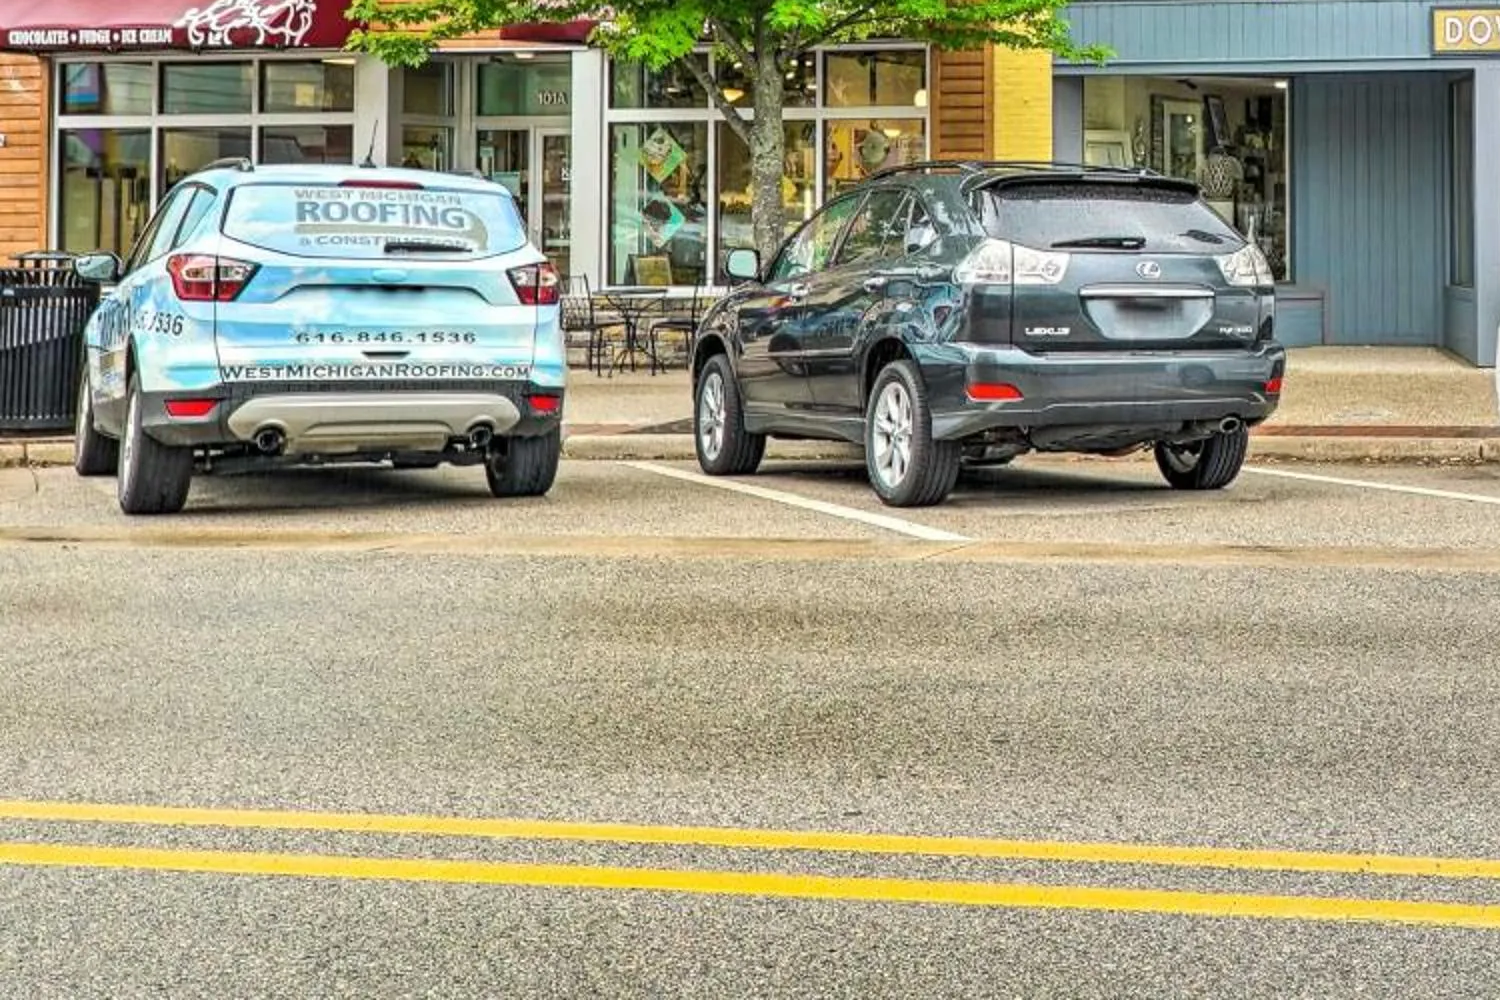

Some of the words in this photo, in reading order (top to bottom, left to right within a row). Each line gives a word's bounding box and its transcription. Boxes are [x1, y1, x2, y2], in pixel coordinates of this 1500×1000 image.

[8, 29, 69, 45] CHOCOLATES
[79, 29, 111, 43] FUDGE
[121, 29, 137, 43] ICE
[140, 29, 173, 43] CREAM
[537, 91, 568, 105] 101A
[293, 189, 353, 200] WEST
[358, 189, 461, 206] MICHIGAN
[295, 200, 466, 229] ROOFING
[296, 331, 477, 344] 616.846.1536
